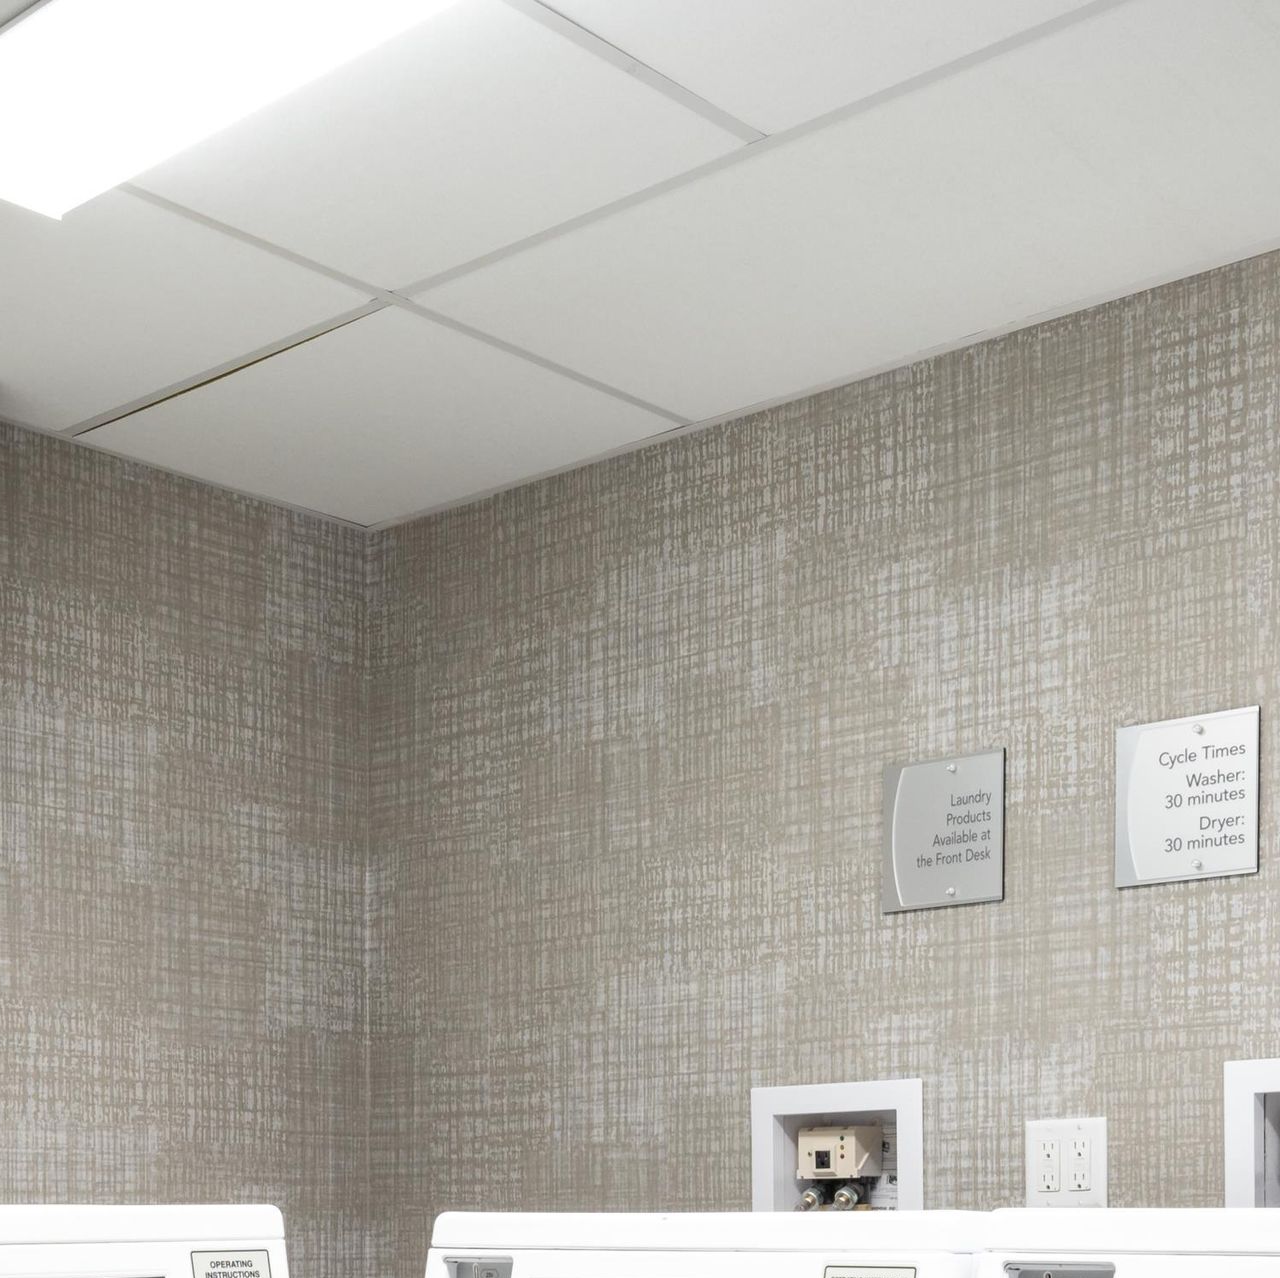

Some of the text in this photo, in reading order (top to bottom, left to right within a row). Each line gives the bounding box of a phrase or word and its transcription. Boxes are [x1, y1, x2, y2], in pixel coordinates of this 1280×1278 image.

[1159, 744, 1246, 769] Cycle Times
[1186, 769, 1245, 788] Washer:
[950, 789, 992, 806] Laundry
[1165, 789, 1246, 809] 30 minutes
[946, 810, 991, 826] Products
[1200, 816, 1245, 833] Dryer:
[932, 829, 991, 847] Available at
[1165, 834, 1245, 853] 30 minutes
[916, 846, 991, 868] the Front Desk
[210, 1260, 253, 1268] OPERATING
[205, 1271, 260, 1278] INSTRUCTIONS
